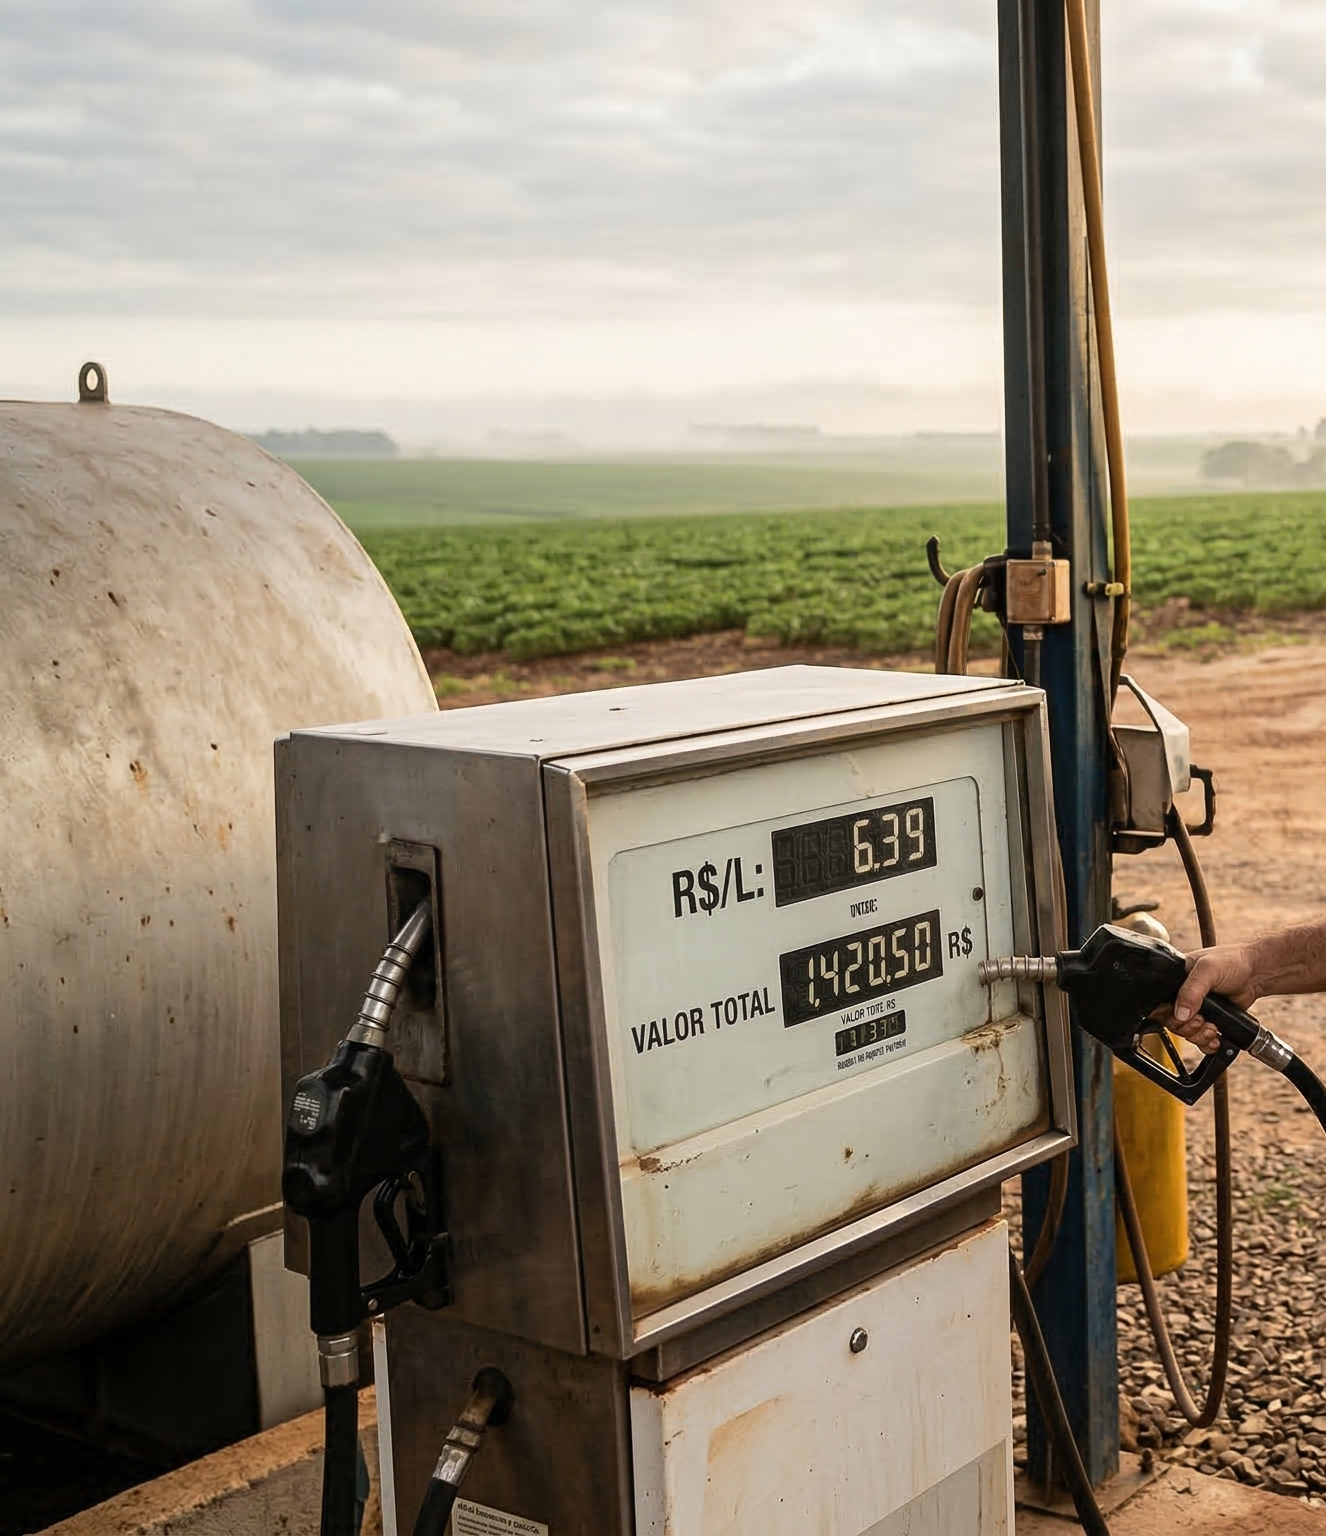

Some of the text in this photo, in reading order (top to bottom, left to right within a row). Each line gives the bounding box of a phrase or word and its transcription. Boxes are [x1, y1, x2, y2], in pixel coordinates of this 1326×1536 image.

[672, 857, 764, 918] R$/L:
[948, 926, 973, 959] R$
[631, 987, 775, 1054] VALOR TOTAL
[840, 1008, 865, 1025] VALOR
